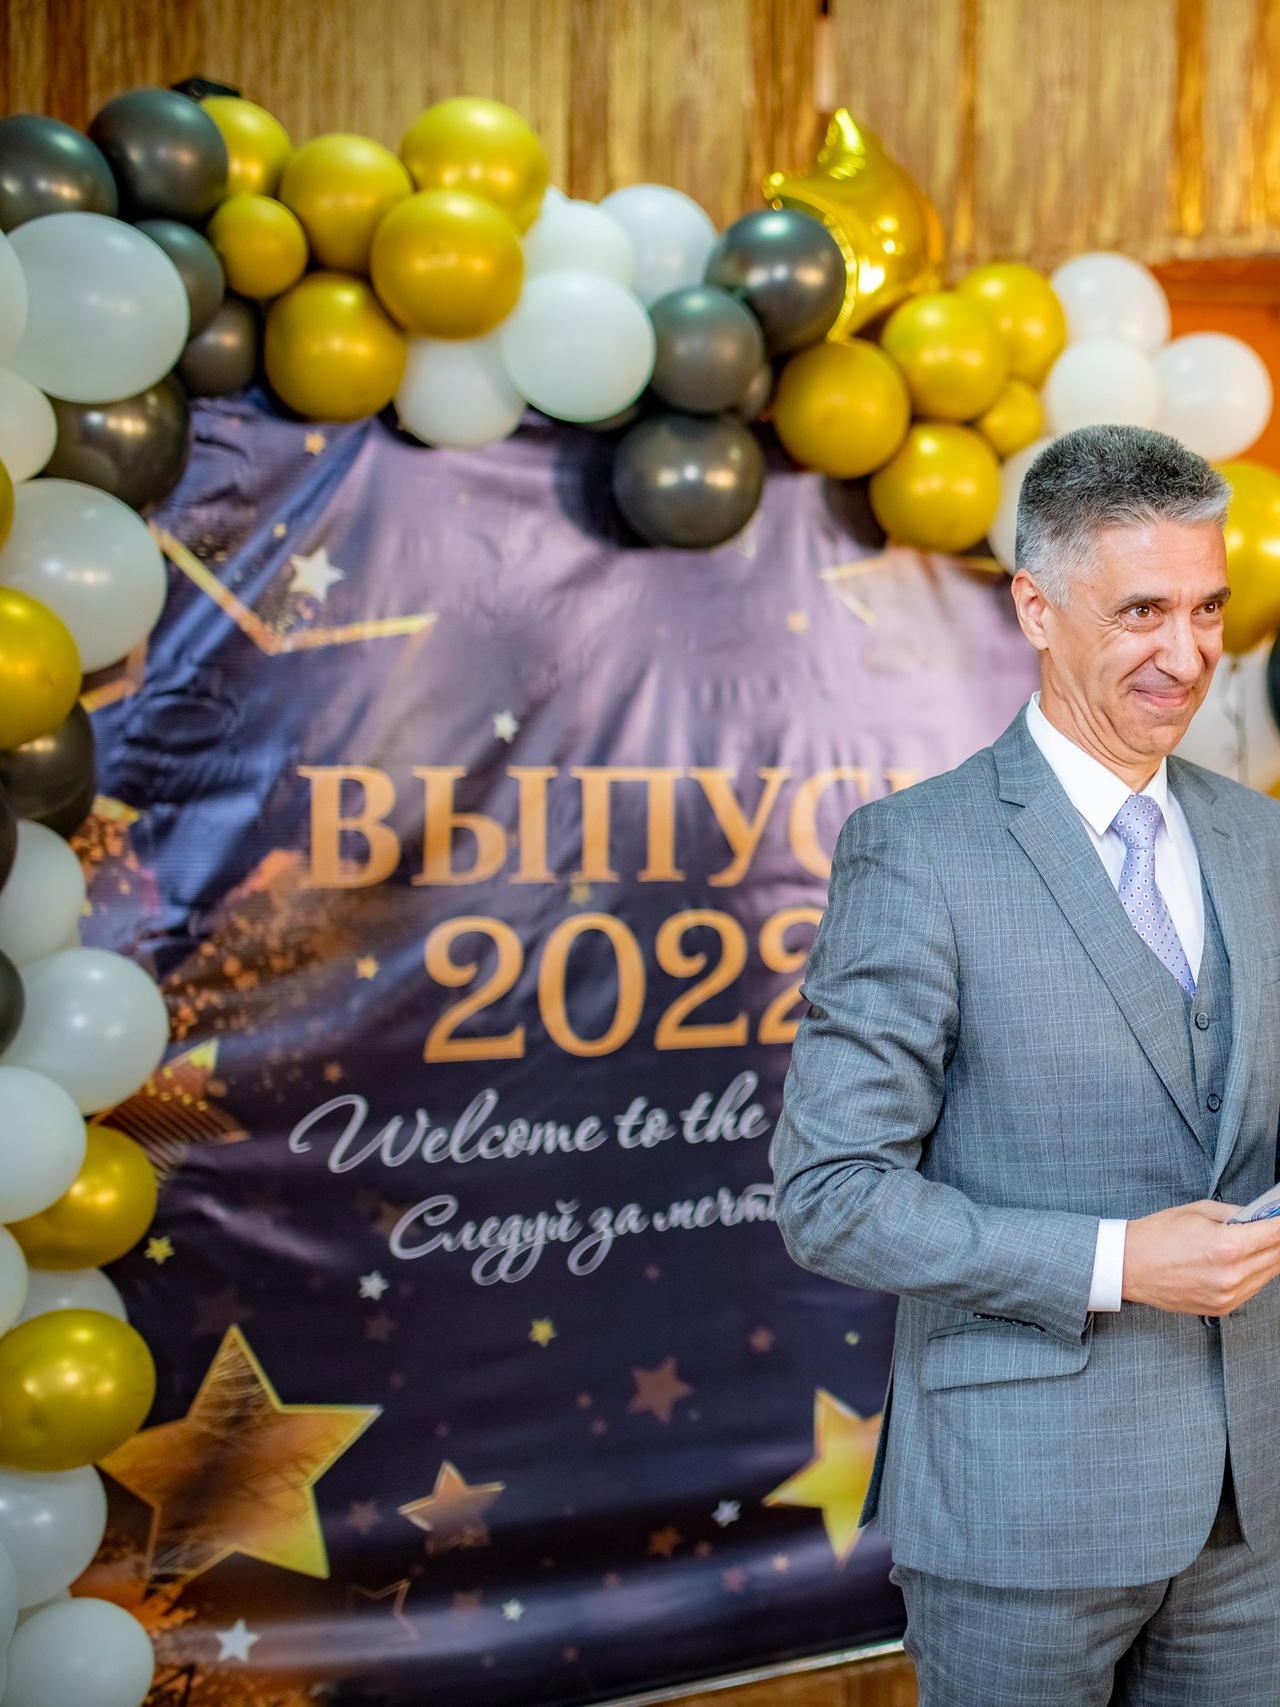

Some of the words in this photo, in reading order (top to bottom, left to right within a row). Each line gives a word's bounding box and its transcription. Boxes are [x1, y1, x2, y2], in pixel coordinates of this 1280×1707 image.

[298, 765, 919, 889] ВЫПУС
[289, 1087, 608, 1174] Welcome
[614, 1096, 677, 1149] to
[679, 1070, 772, 1145] the
[389, 1195, 583, 1286] Следуй
[567, 1203, 650, 1276] за
